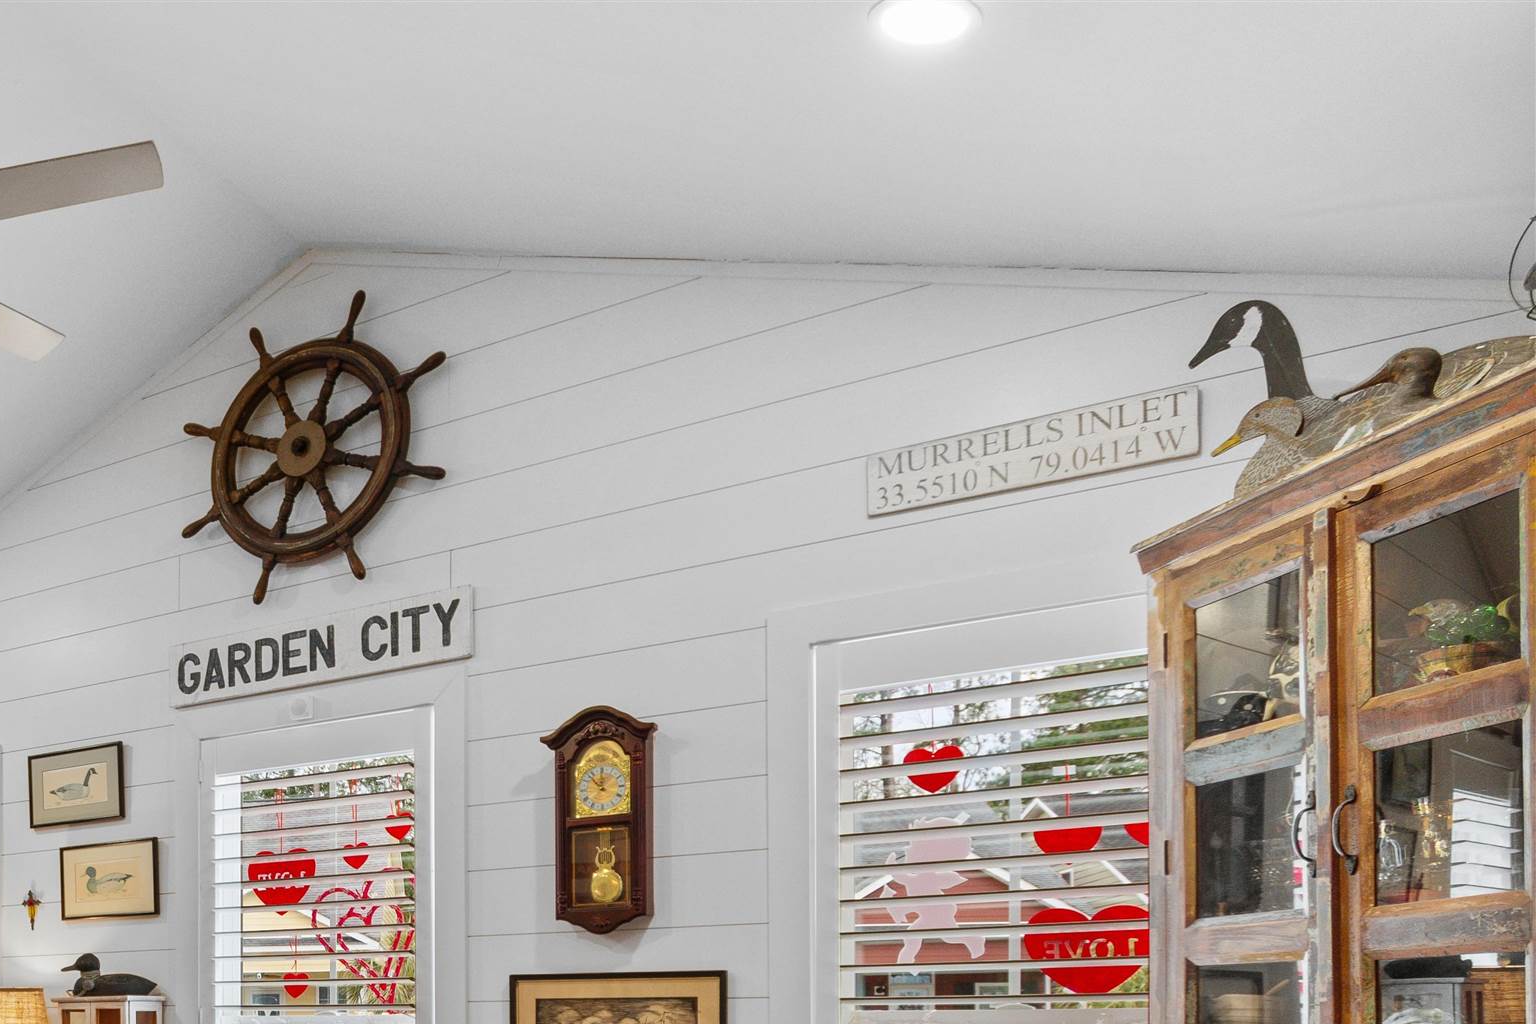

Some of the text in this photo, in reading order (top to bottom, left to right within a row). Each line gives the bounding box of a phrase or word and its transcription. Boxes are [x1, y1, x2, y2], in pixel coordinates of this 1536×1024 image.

[877, 390, 1188, 478] MURRELLS INLET
[177, 598, 461, 695] GARDEN CITY
